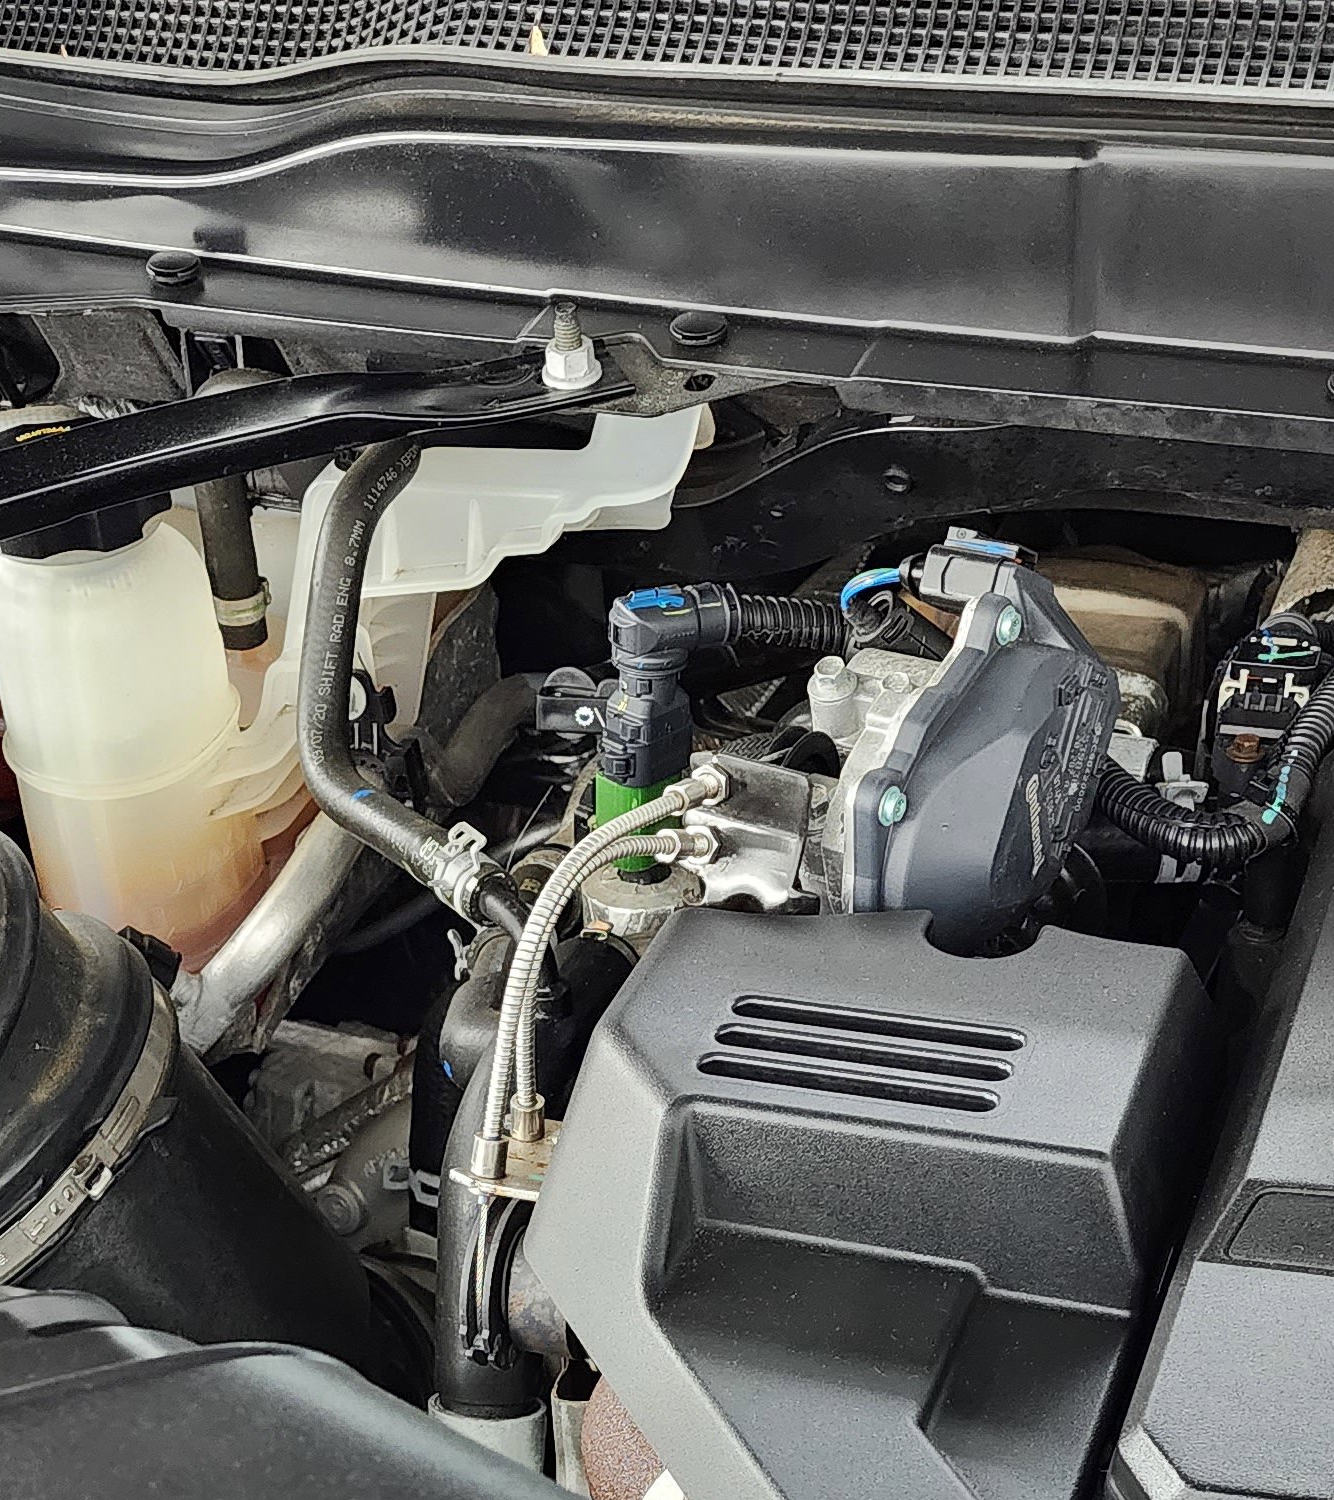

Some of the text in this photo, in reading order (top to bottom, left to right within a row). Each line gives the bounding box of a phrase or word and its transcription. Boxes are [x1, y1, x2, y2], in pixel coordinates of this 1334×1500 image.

[363, 466, 398, 511] 1114746
[343, 519, 366, 567] 8.7MM
[335, 576, 352, 606] ENG
[328, 614, 346, 643] RAD
[318, 651, 339, 696] SHIFT
